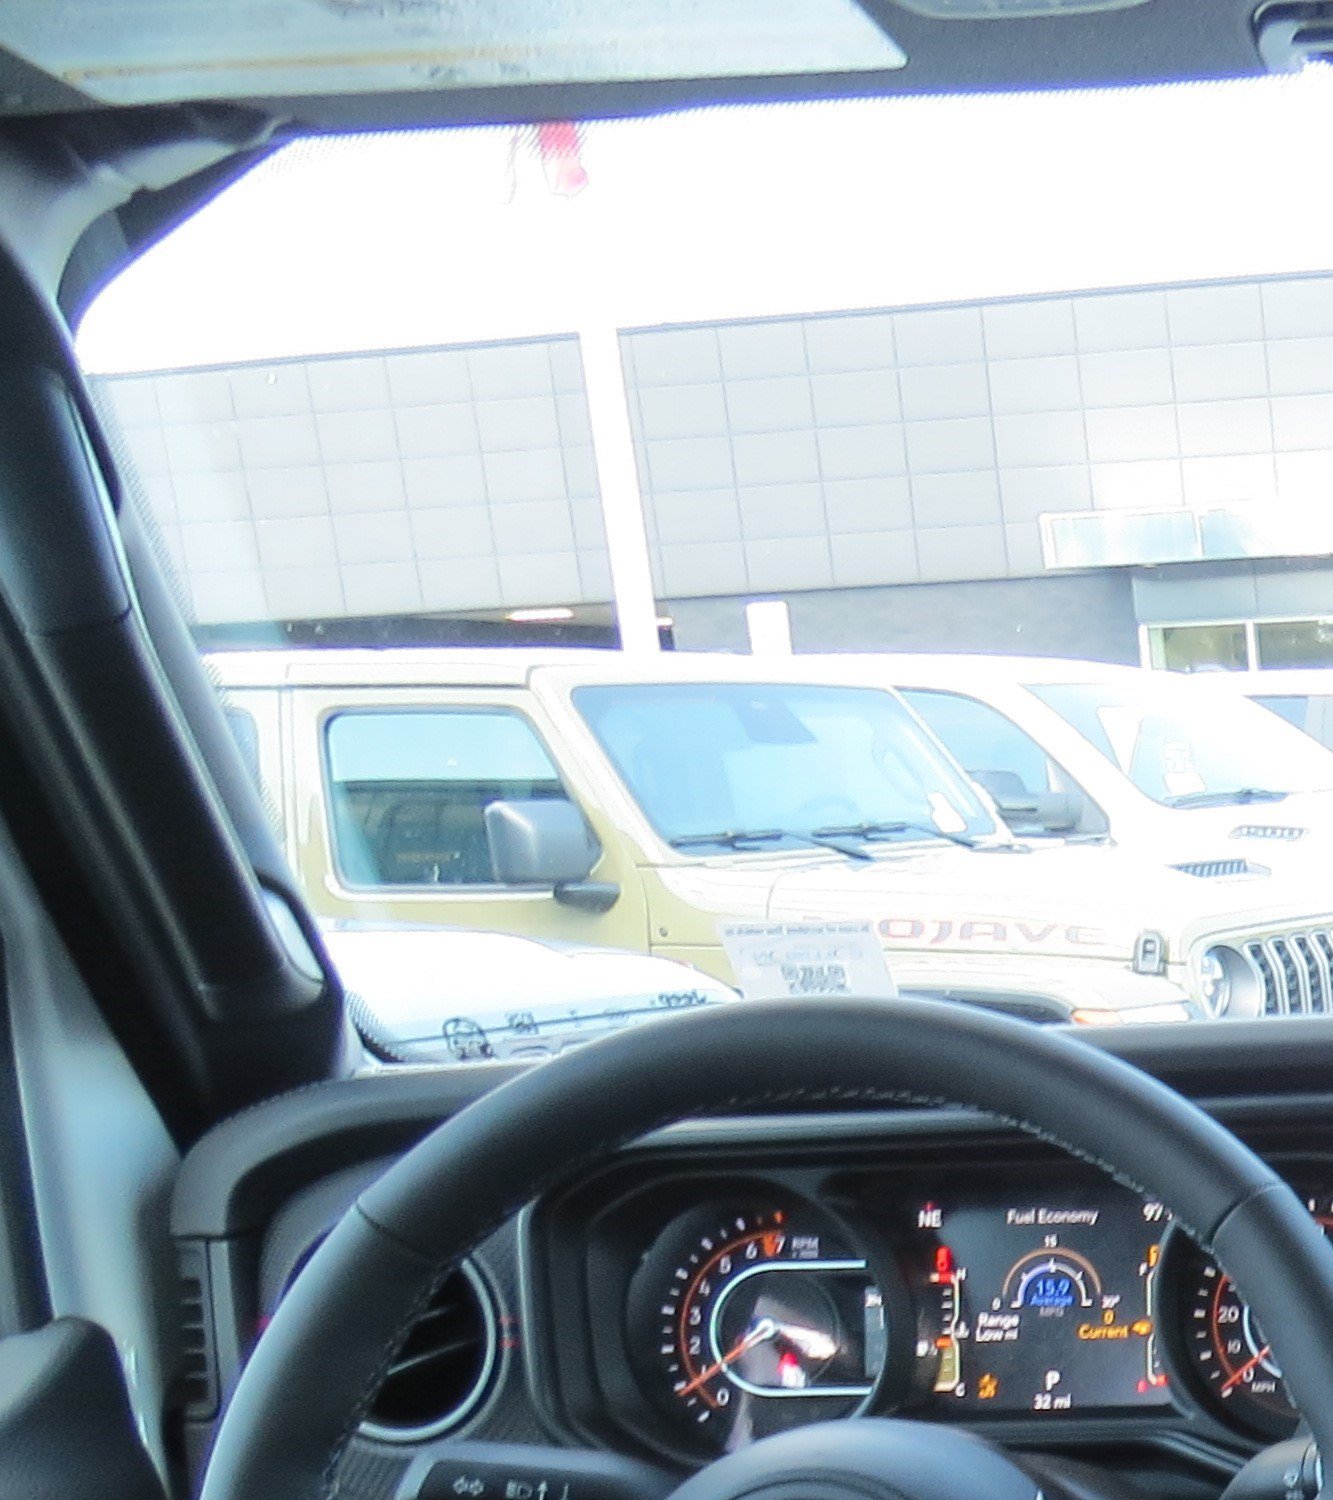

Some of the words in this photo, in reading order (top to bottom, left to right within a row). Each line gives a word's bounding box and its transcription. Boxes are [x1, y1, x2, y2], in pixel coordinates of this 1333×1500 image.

[918, 1209, 943, 1228] NE
[1007, 1207, 1035, 1225] Fuel
[1038, 1208, 1099, 1226] Economy
[745, 1242, 758, 1260] 6
[775, 1234, 786, 1255] 7
[719, 1255, 732, 1275] 5
[698, 1279, 711, 1297] 4
[690, 1305, 702, 1326] 3
[977, 1312, 1021, 1330] Range
[1217, 1304, 1240, 1325] 20
[974, 1326, 1004, 1343] Low
[1078, 1322, 1130, 1341] Current
[690, 1336, 702, 1356] 2
[1226, 1338, 1242, 1355] 10
[1045, 1369, 1061, 1391] P
[716, 1387, 730, 1407] 0
[1033, 1392, 1053, 1411] 32
[1054, 1393, 1072, 1410] mi
